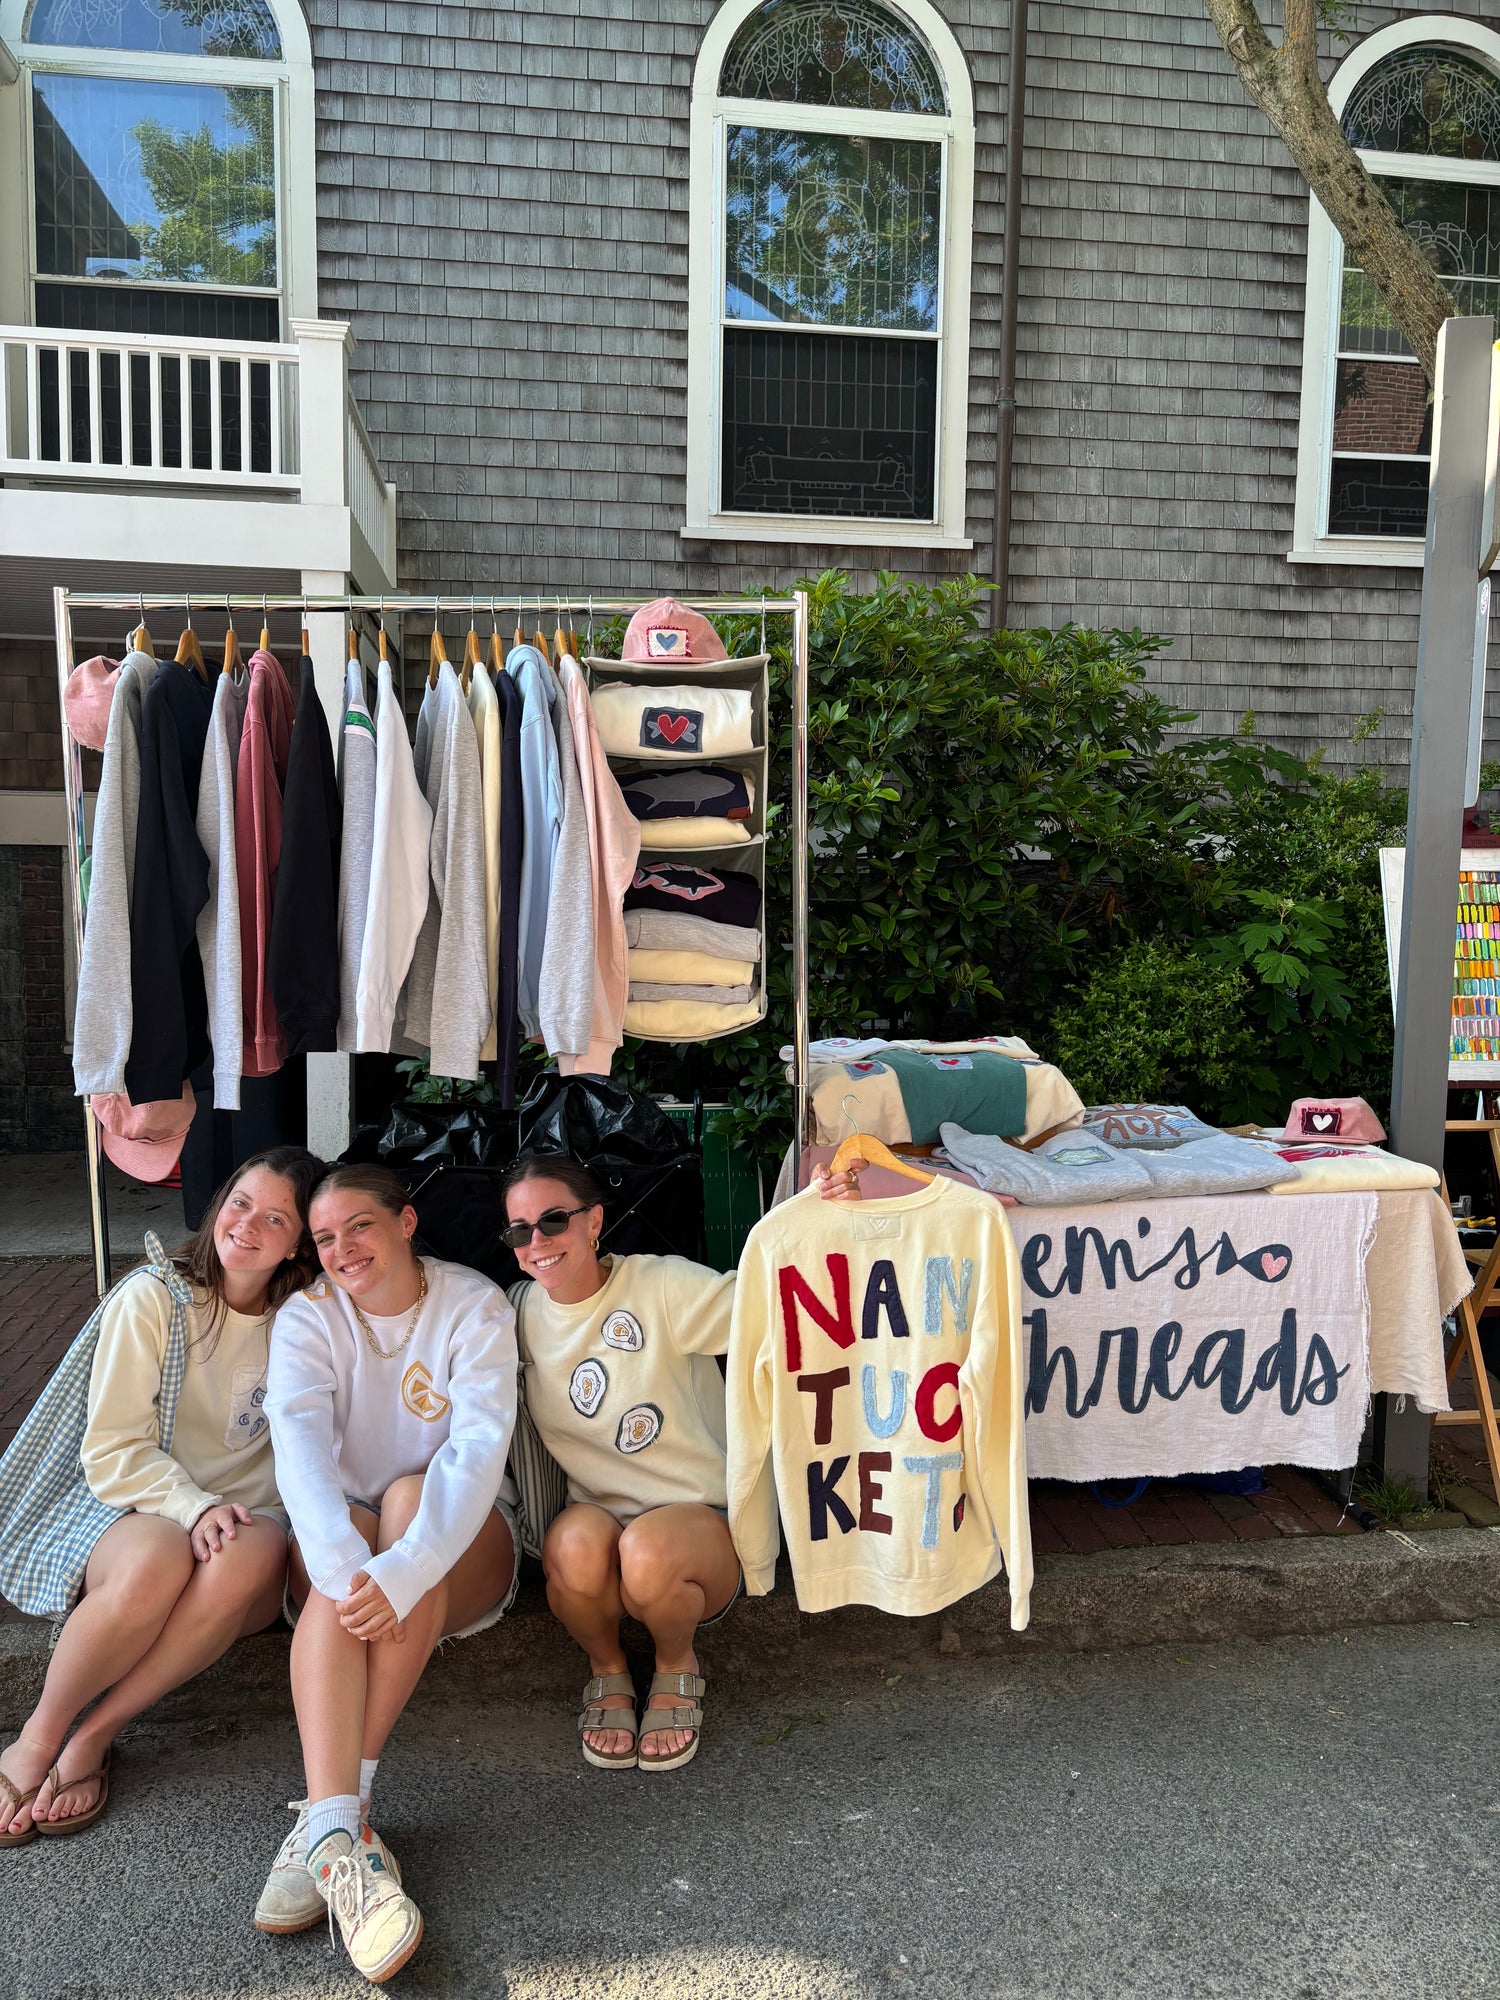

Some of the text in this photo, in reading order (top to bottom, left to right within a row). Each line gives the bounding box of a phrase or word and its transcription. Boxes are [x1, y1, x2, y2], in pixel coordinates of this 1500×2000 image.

[1102, 1115, 1181, 1140] ACK
[1022, 1216, 1204, 1299] em's
[778, 1252, 975, 1373] NAN
[796, 1361, 964, 1445] TUC
[1022, 1307, 1351, 1422] hreads
